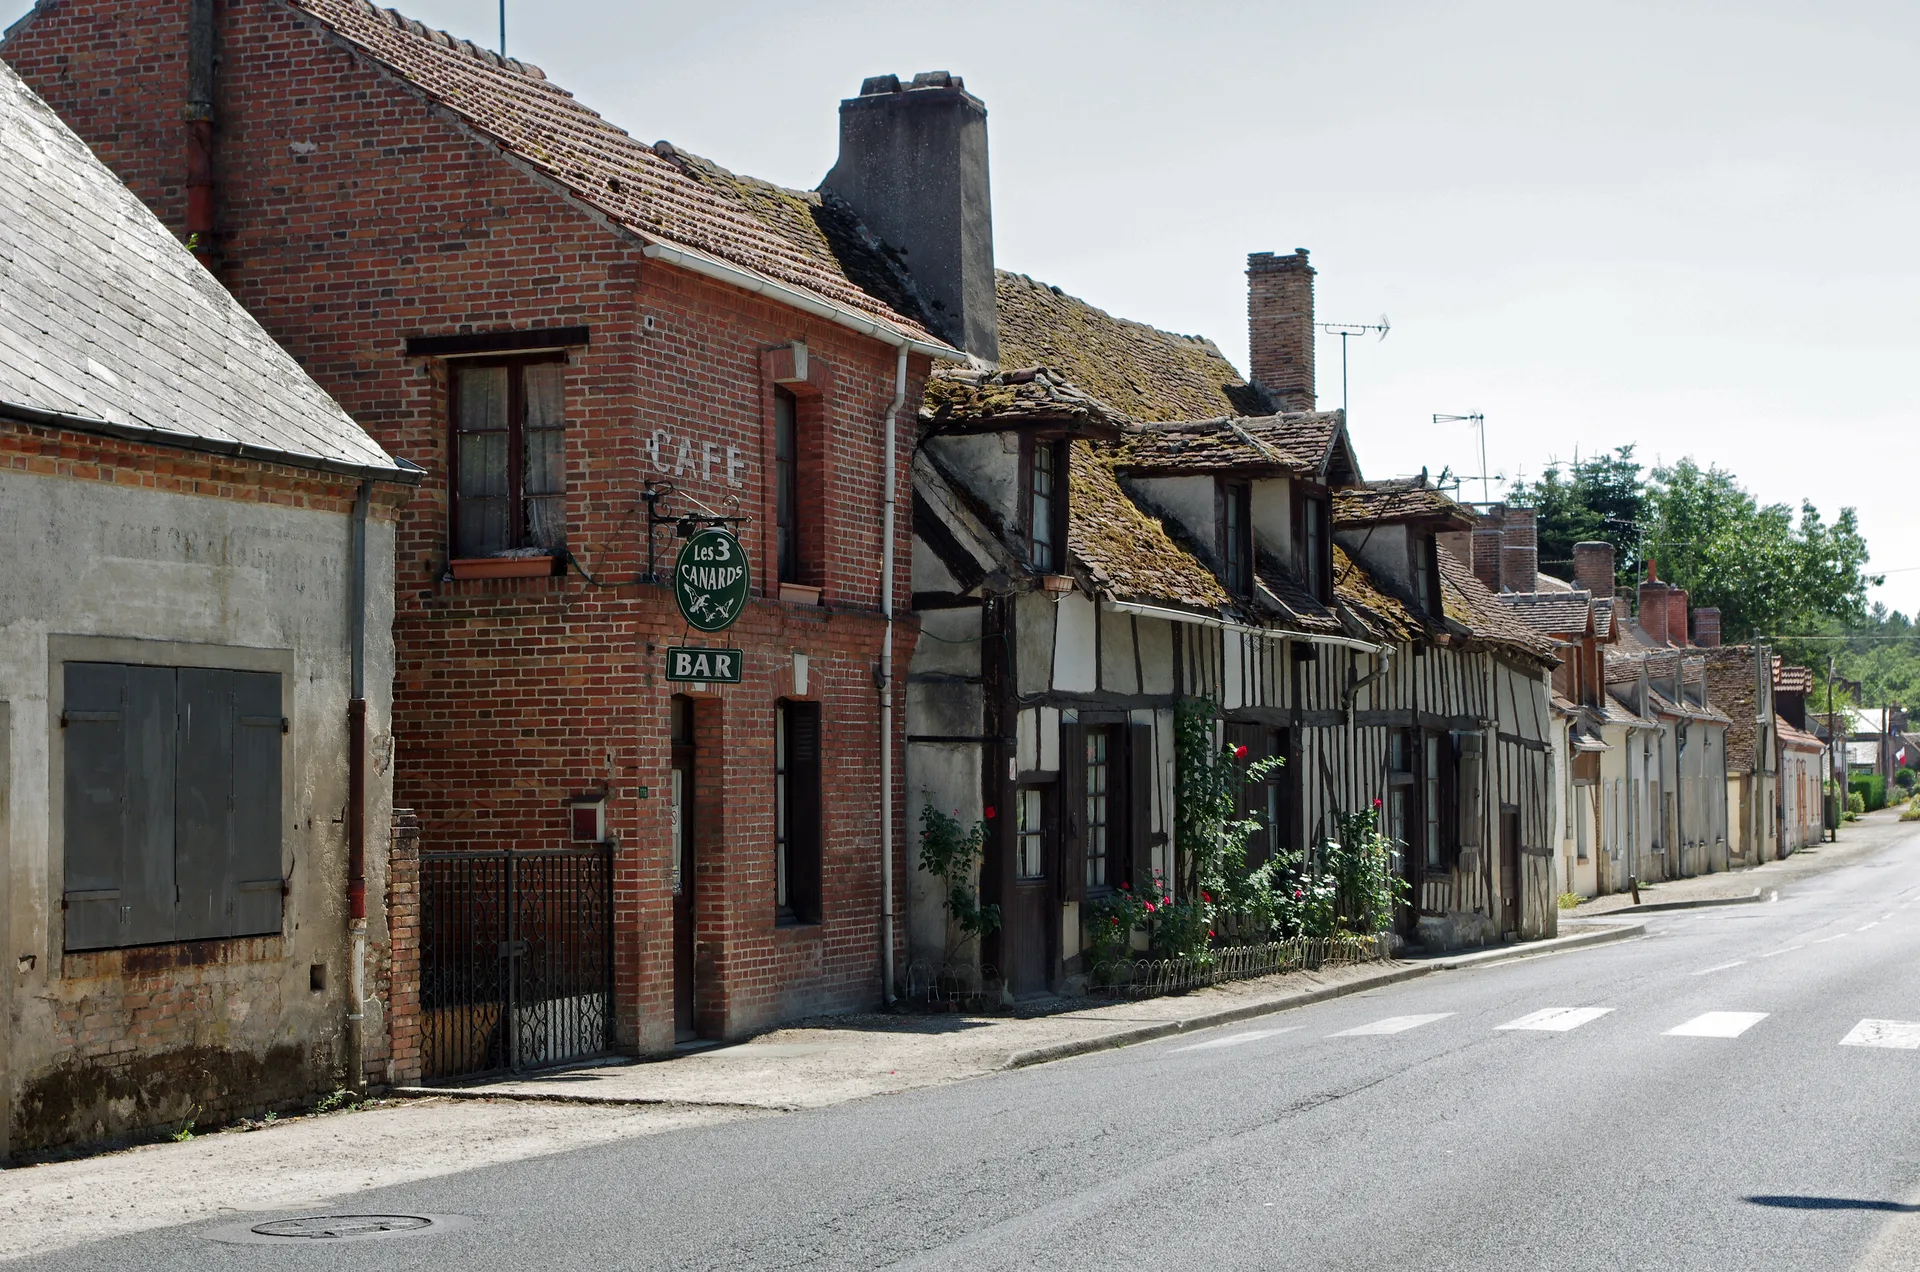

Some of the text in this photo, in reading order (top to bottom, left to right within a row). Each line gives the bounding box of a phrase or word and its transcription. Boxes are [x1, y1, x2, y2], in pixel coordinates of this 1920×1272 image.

[694, 537, 731, 561] Les 3
[681, 564, 743, 590] CANARDS
[675, 653, 732, 678] BAR
